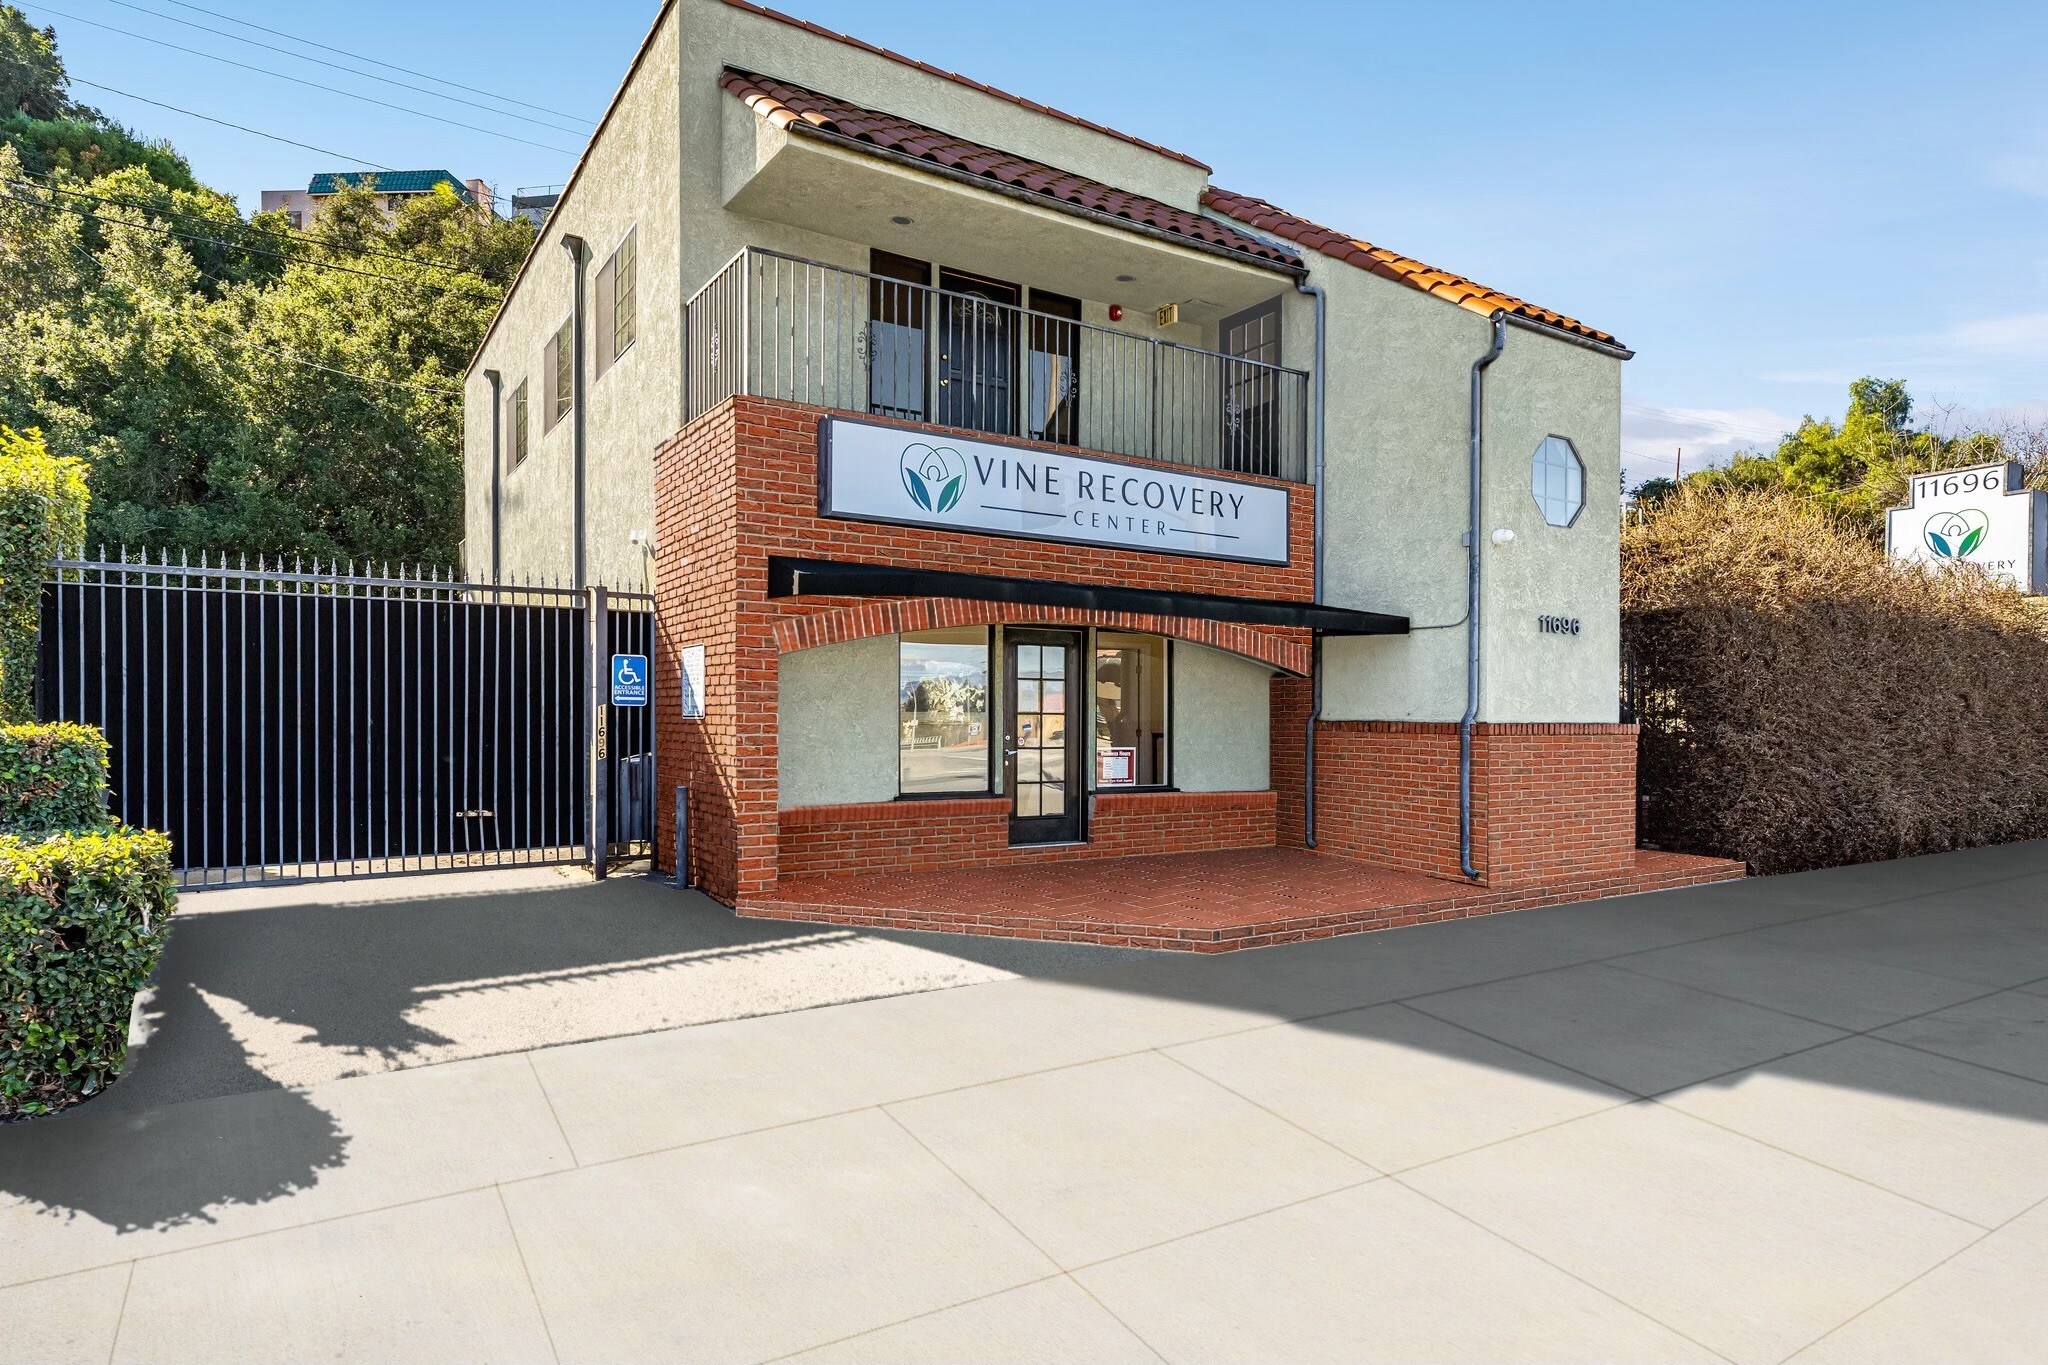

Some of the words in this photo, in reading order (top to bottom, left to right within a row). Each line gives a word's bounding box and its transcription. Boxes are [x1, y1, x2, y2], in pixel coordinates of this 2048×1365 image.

[1159, 306, 1173, 326] EXIT
[973, 455, 1060, 496] VINE
[1078, 471, 1244, 520] RECOVERY
[1917, 470, 2000, 499] 11696
[1073, 510, 1167, 536] CENTER
[1538, 615, 1581, 635] 11696
[598, 705, 606, 759] 11696
